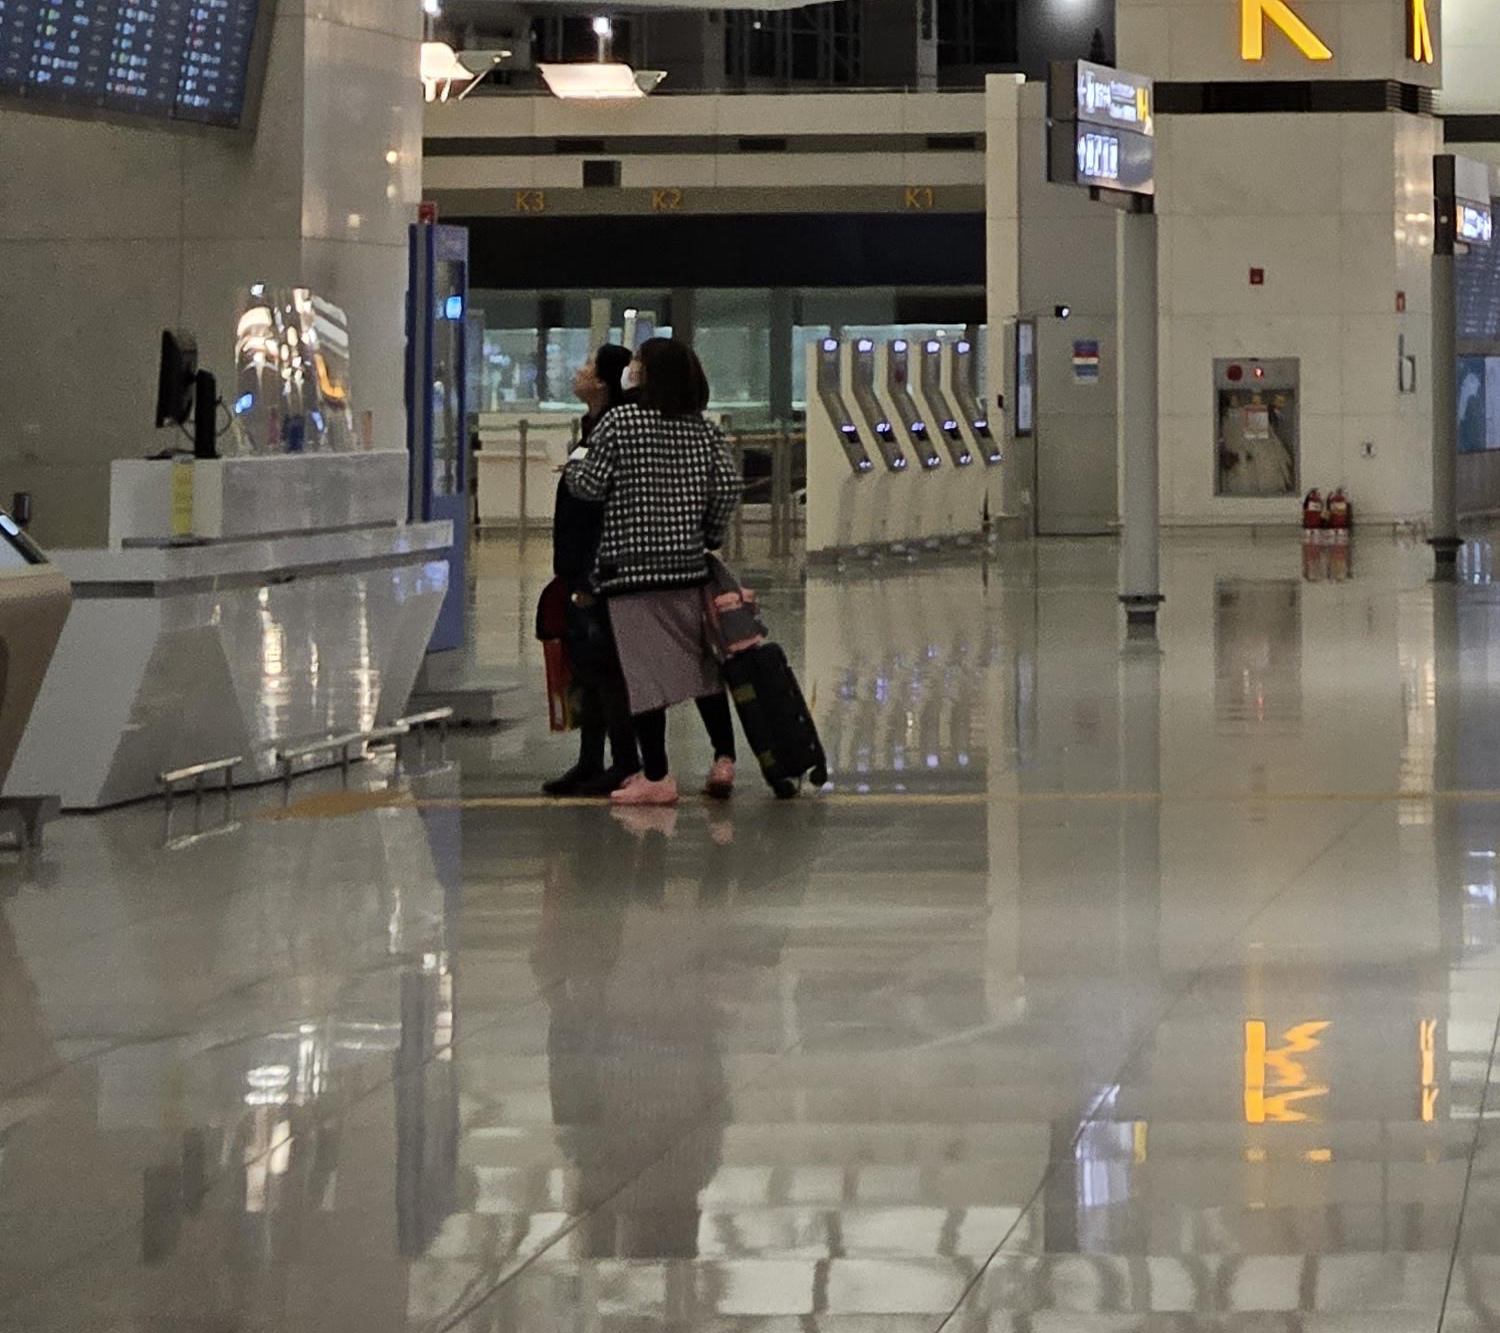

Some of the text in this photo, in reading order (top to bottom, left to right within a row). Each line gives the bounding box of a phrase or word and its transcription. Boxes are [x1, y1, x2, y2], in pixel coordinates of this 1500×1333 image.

[515, 190, 545, 211] K3
[651, 189, 682, 210] K2
[905, 187, 935, 209] K1
